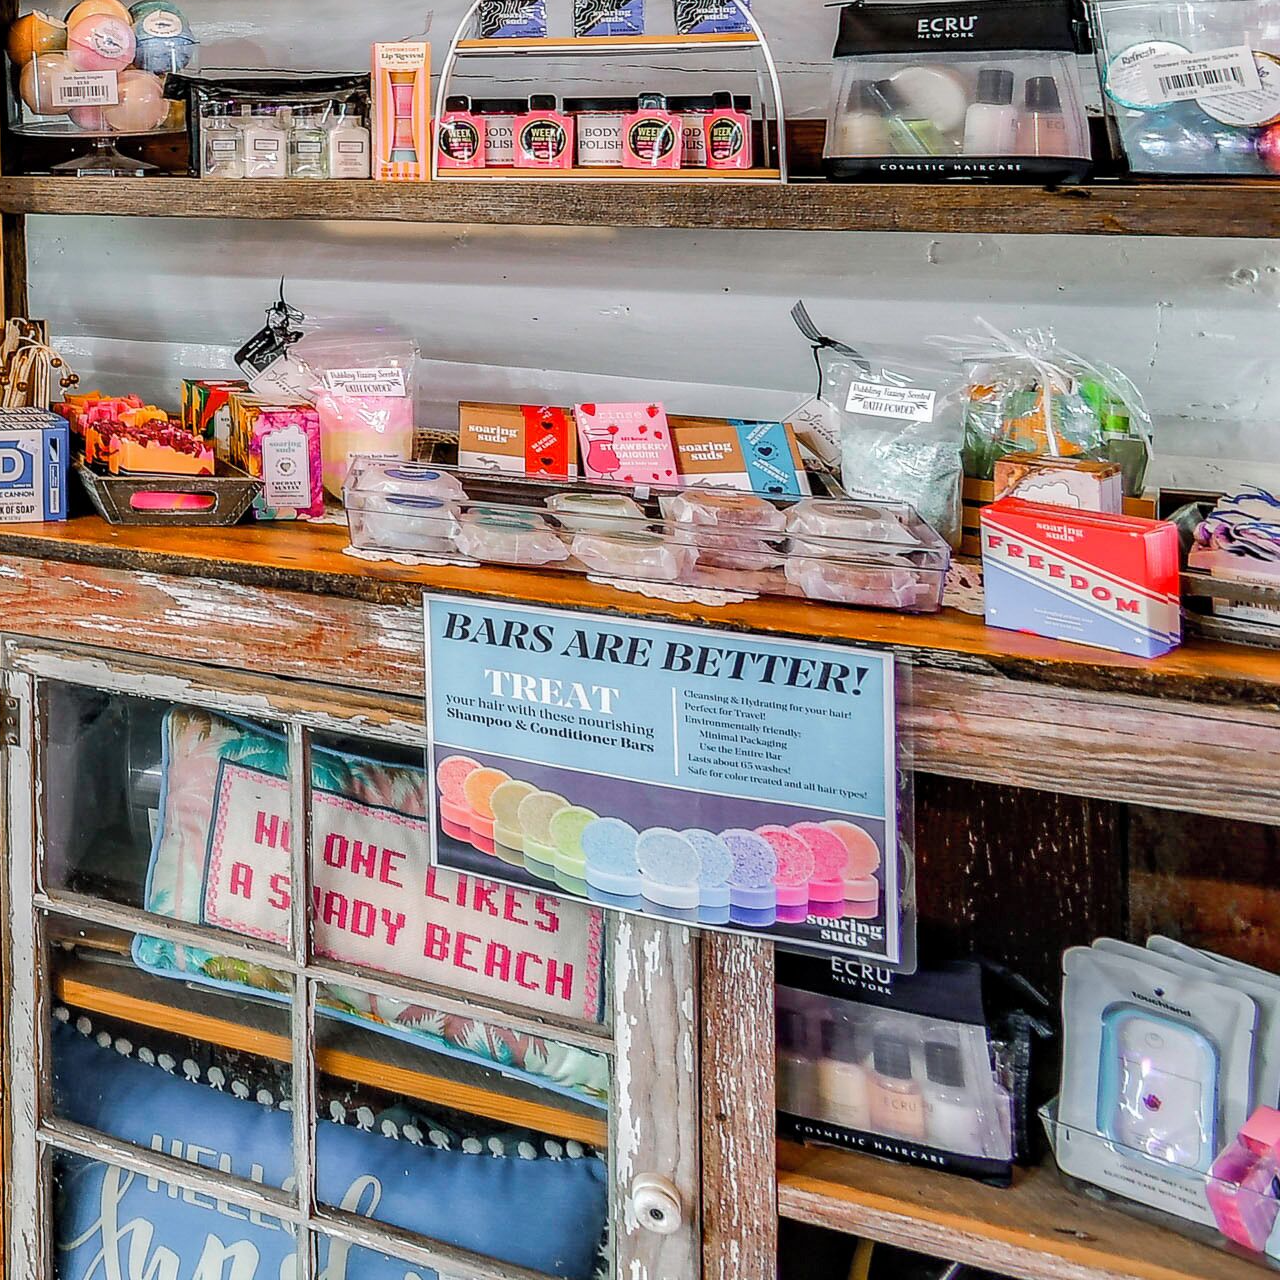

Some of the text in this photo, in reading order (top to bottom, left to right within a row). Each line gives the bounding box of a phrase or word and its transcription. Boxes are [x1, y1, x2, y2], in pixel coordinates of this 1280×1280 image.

[1036, 521, 1085, 538] soaring
[1046, 532, 1075, 543] suds
[987, 533, 1142, 615] FREEDOM
[442, 611, 869, 697] BARS ARE BETTER!
[484, 669, 620, 716] TREAT
[684, 689, 852, 719] Cleansing Hydrating your hair!
[446, 693, 655, 739] your hair with these nourishing
[684, 702, 766, 721] Perfect Travel!
[685, 715, 760, 733] Environmentally
[446, 707, 655, 753] Shampoo & Conditioner Bars
[699, 730, 788, 750] Minimal Packaging
[688, 753, 791, 775] Lasts about washes!
[735, 748, 763, 759] Entire
[688, 766, 868, 800] Safe color treated hair types!
[323, 832, 562, 935] ONE LIKES
[229, 861, 575, 1001] A BEACH
[806, 914, 885, 942] soaring
[820, 928, 868, 948] suds
